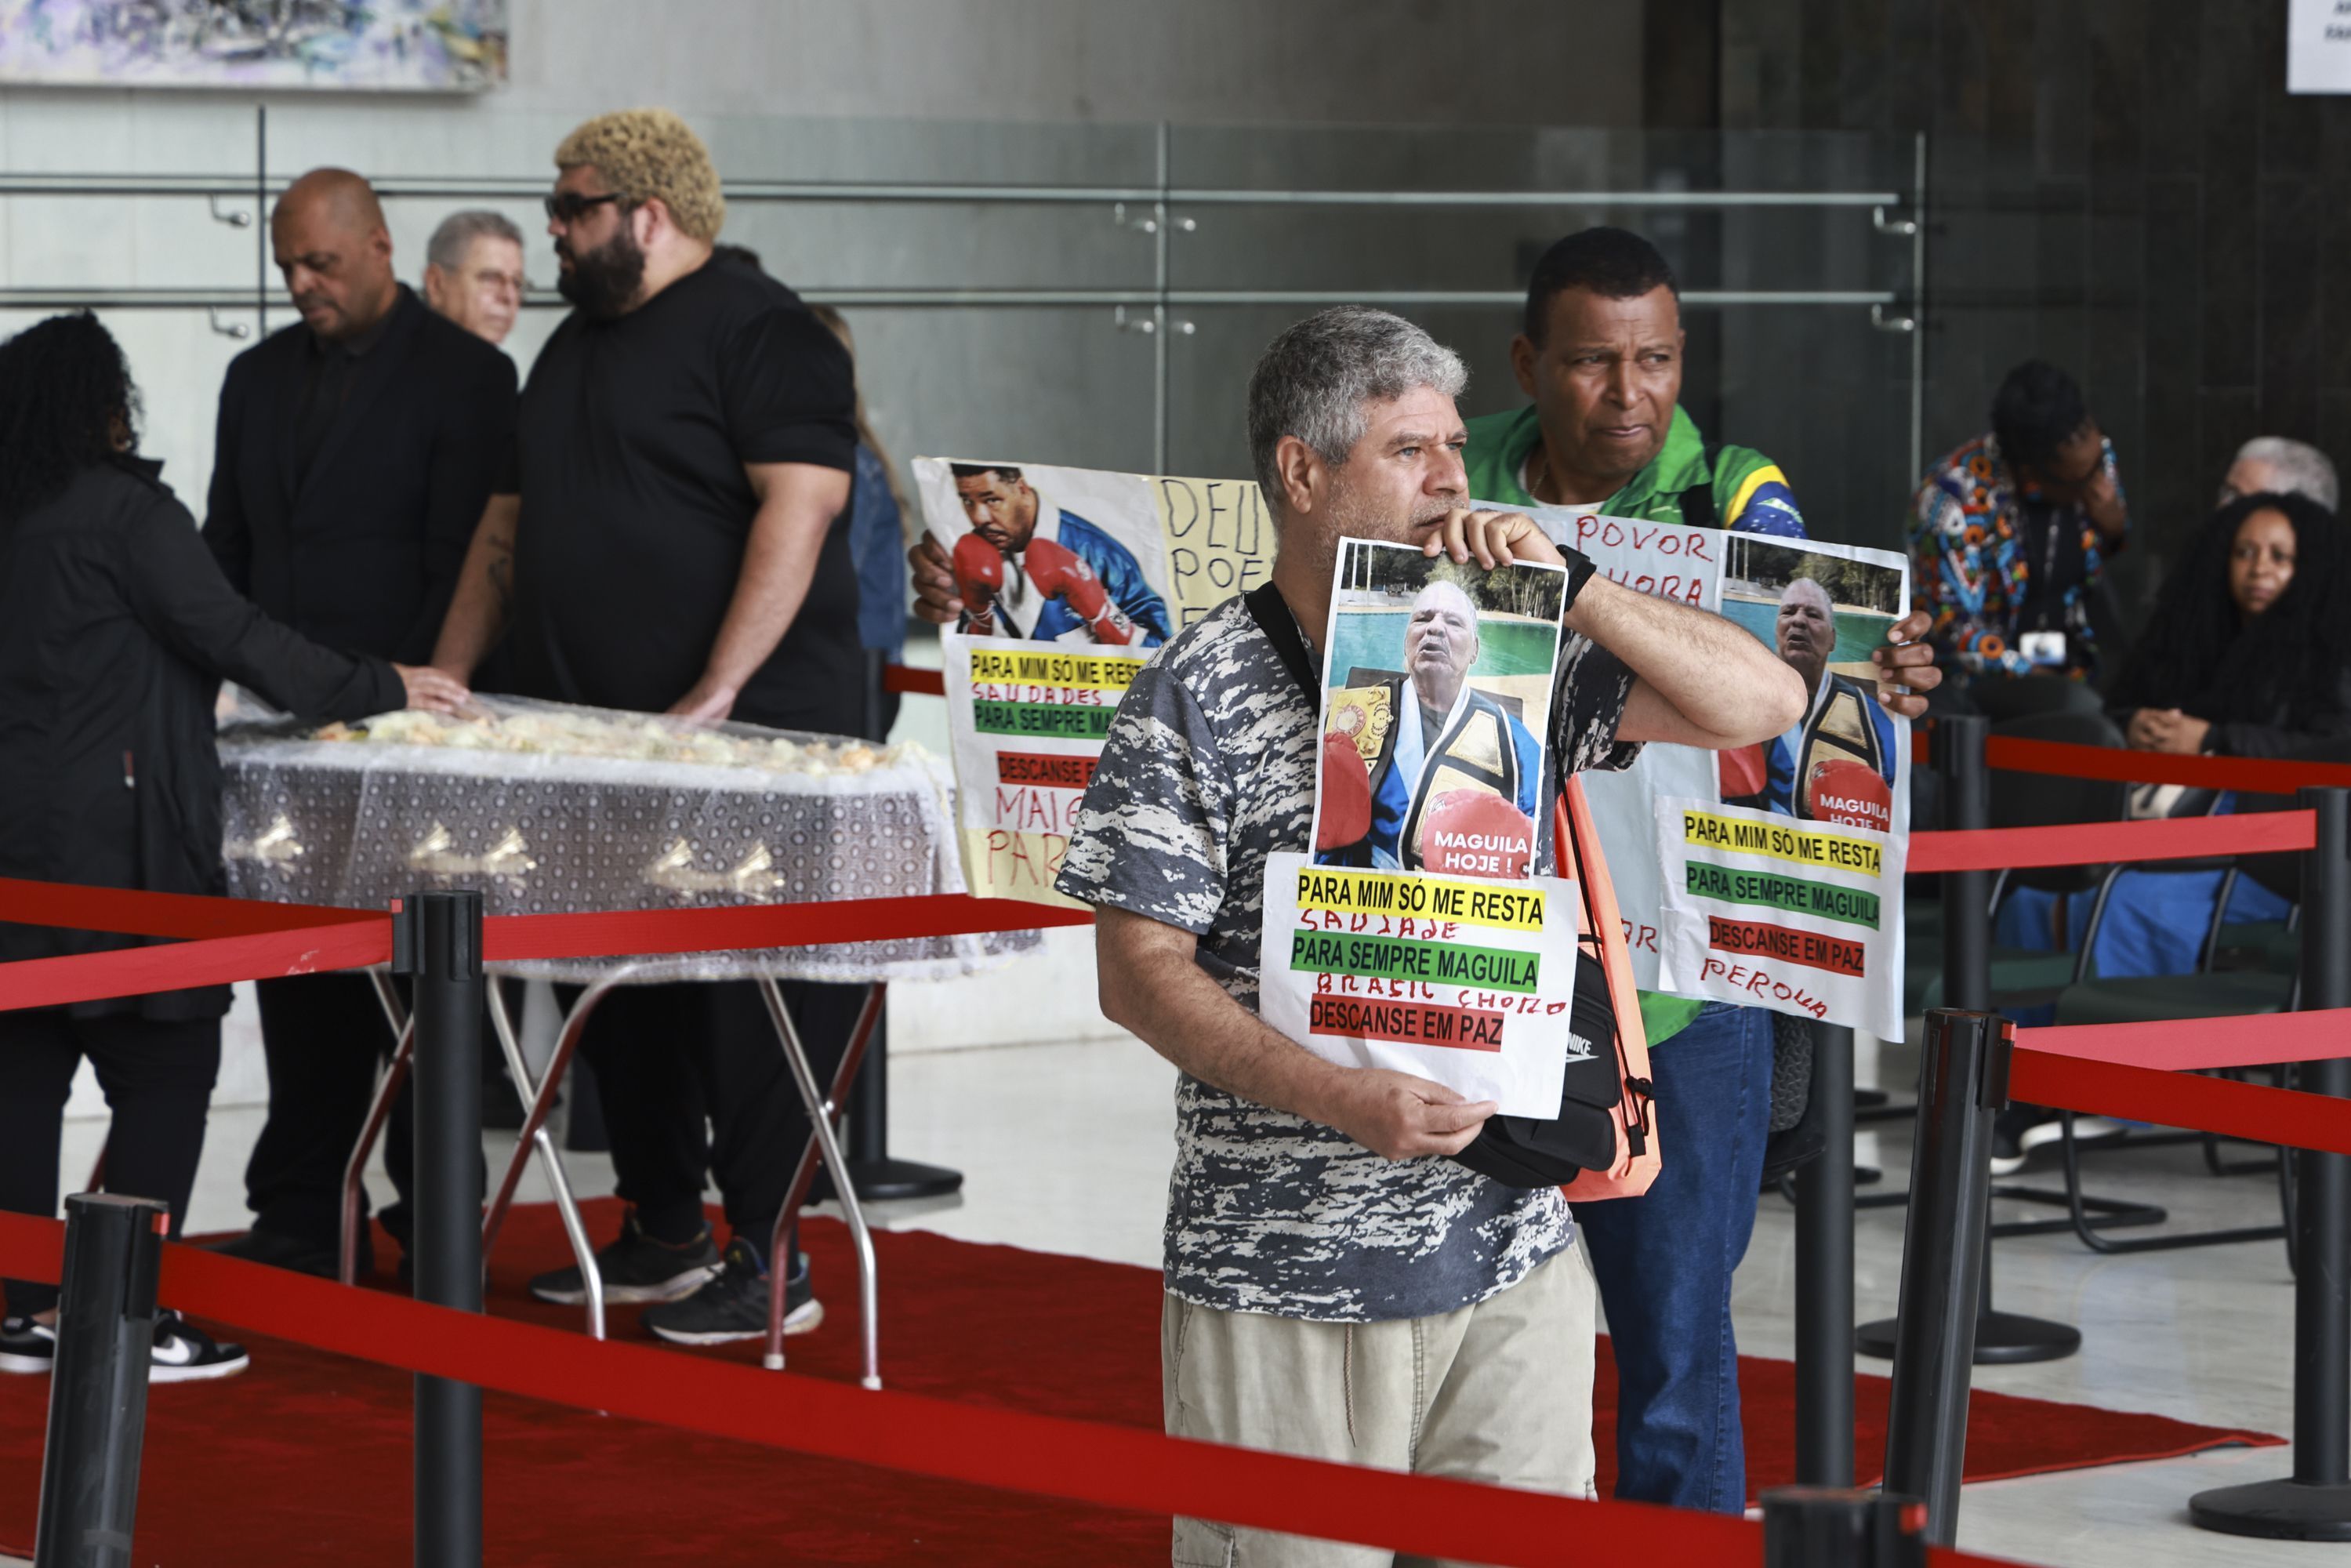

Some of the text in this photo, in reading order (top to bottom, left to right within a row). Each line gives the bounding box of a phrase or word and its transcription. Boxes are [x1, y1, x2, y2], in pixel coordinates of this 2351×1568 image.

[971, 655, 1014, 678] PARA
[1019, 657, 1048, 680] MIM
[1052, 655, 1073, 681] SÓ
[1077, 661, 1101, 684] ME
[971, 682, 1101, 706] SAUDADES
[974, 705, 1016, 729] PARA
[1020, 708, 1086, 732] SEMPRE
[998, 757, 1082, 783] DESCANSE
[1820, 793, 1889, 822] MAGUILA
[1435, 830, 1528, 853] MAGUILA
[1685, 816, 1881, 873] PARA MIM SÓ ME RESTA
[1445, 852, 1500, 872] HOJE
[1297, 875, 1544, 925] PARA MIM SÓ ME RESTA
[1687, 866, 1880, 923] PARA SEMPRE MAGUILA
[1711, 921, 1864, 971] DESCANSE EM PAZ
[1292, 936, 1537, 987] PARA SEMPRE MAGUILA
[1317, 973, 1435, 999] BRASIL
[1310, 1000, 1504, 1046] DESCANSE EM PAZ
[1568, 1032, 1592, 1056] NIKE
